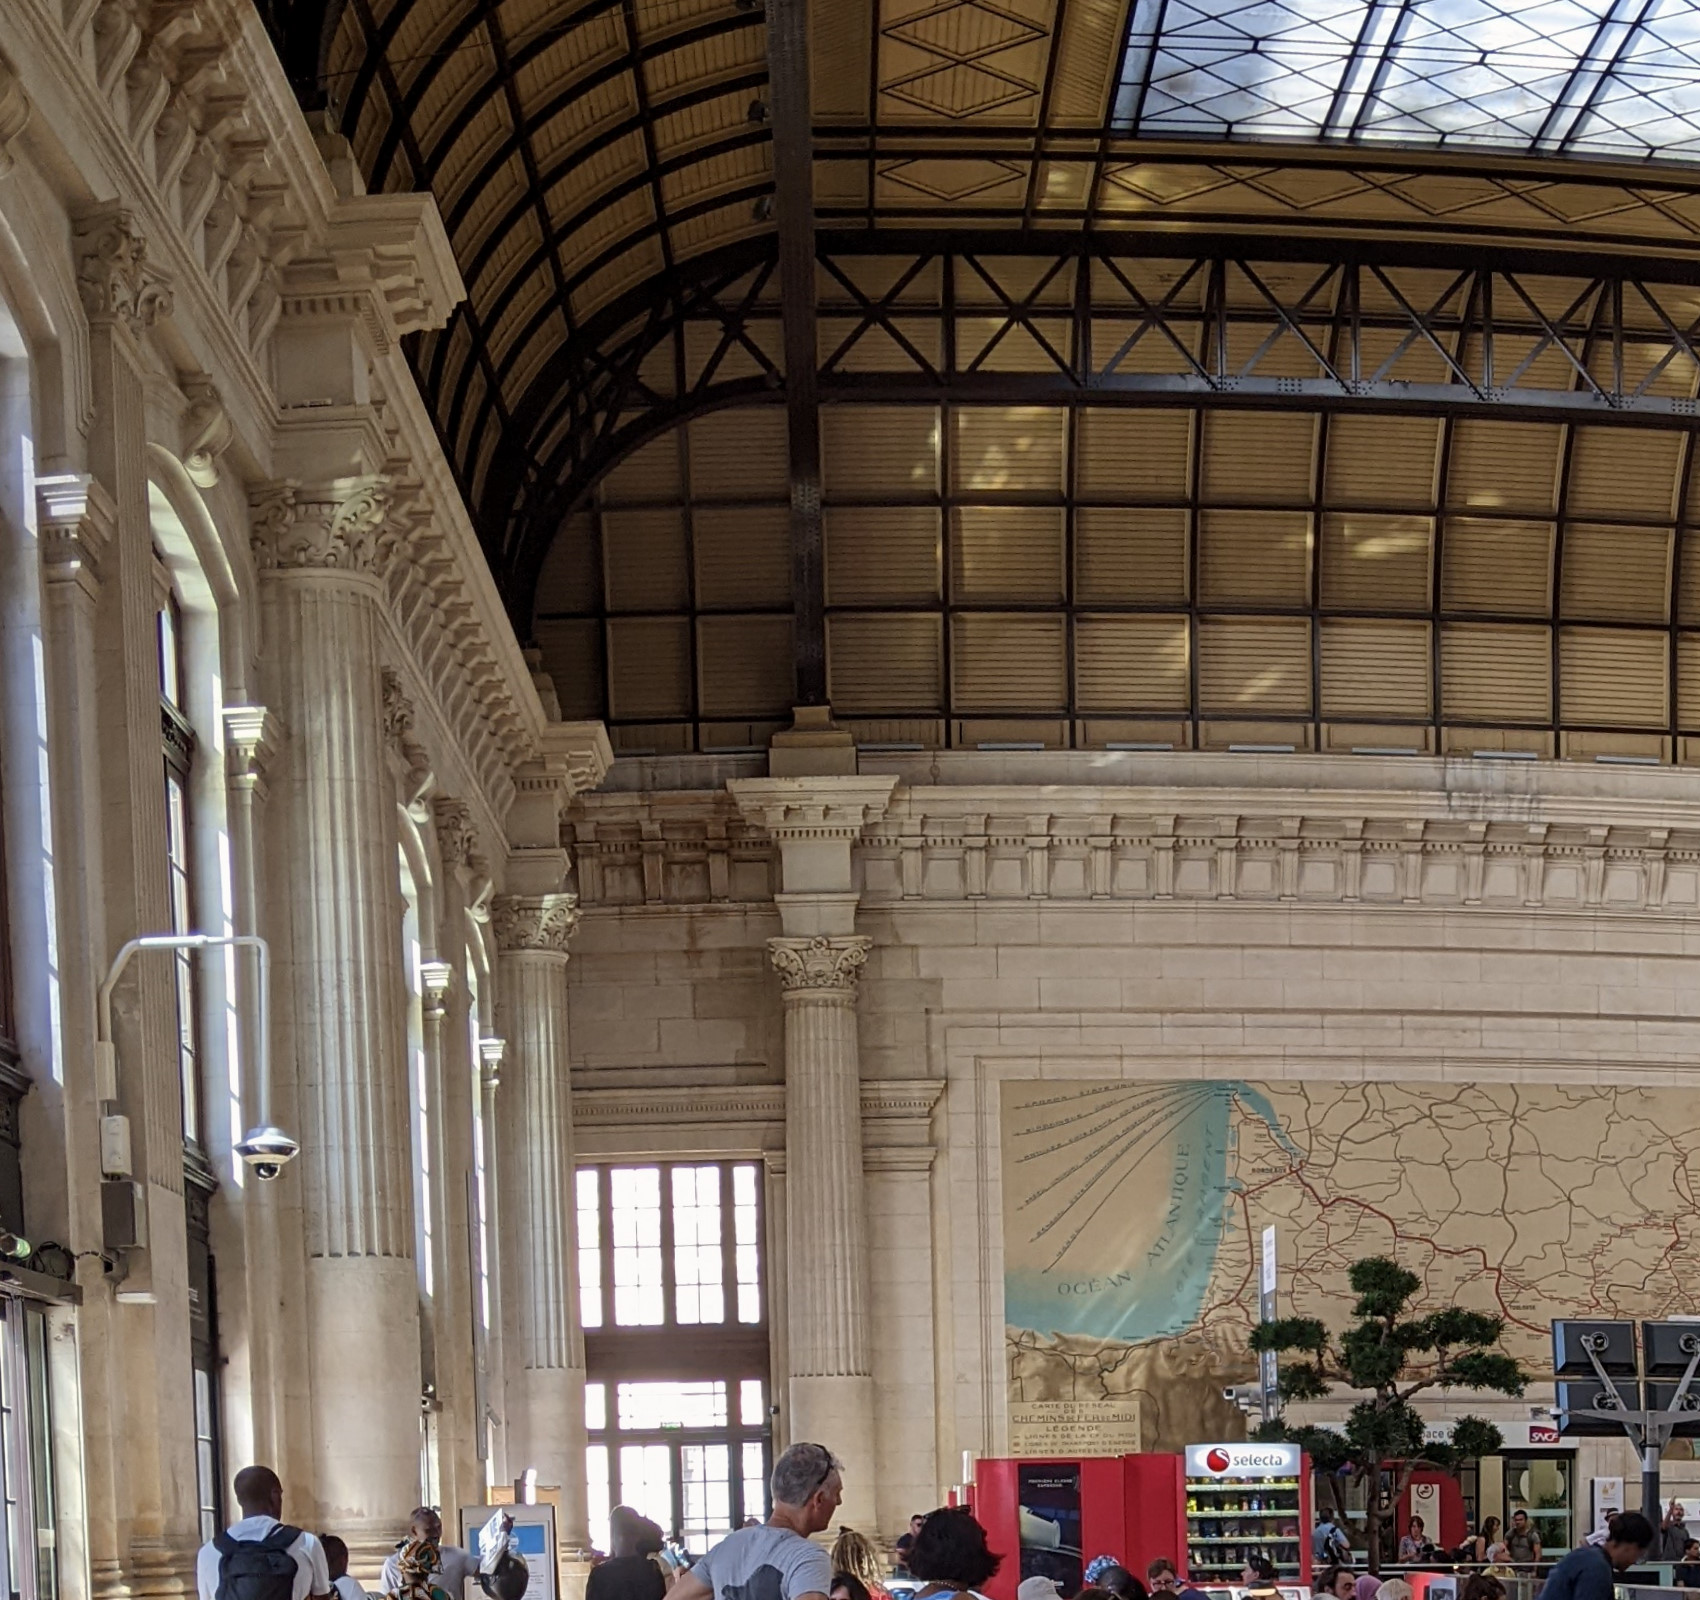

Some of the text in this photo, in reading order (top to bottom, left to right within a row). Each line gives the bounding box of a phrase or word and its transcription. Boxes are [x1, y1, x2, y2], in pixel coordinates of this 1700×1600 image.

[1147, 1143, 1191, 1267] ATLANTIQUE
[1057, 1271, 1132, 1296] OCÉAN
[1530, 1432, 1559, 1442] SNCF
[1233, 1454, 1283, 1466] selecta
